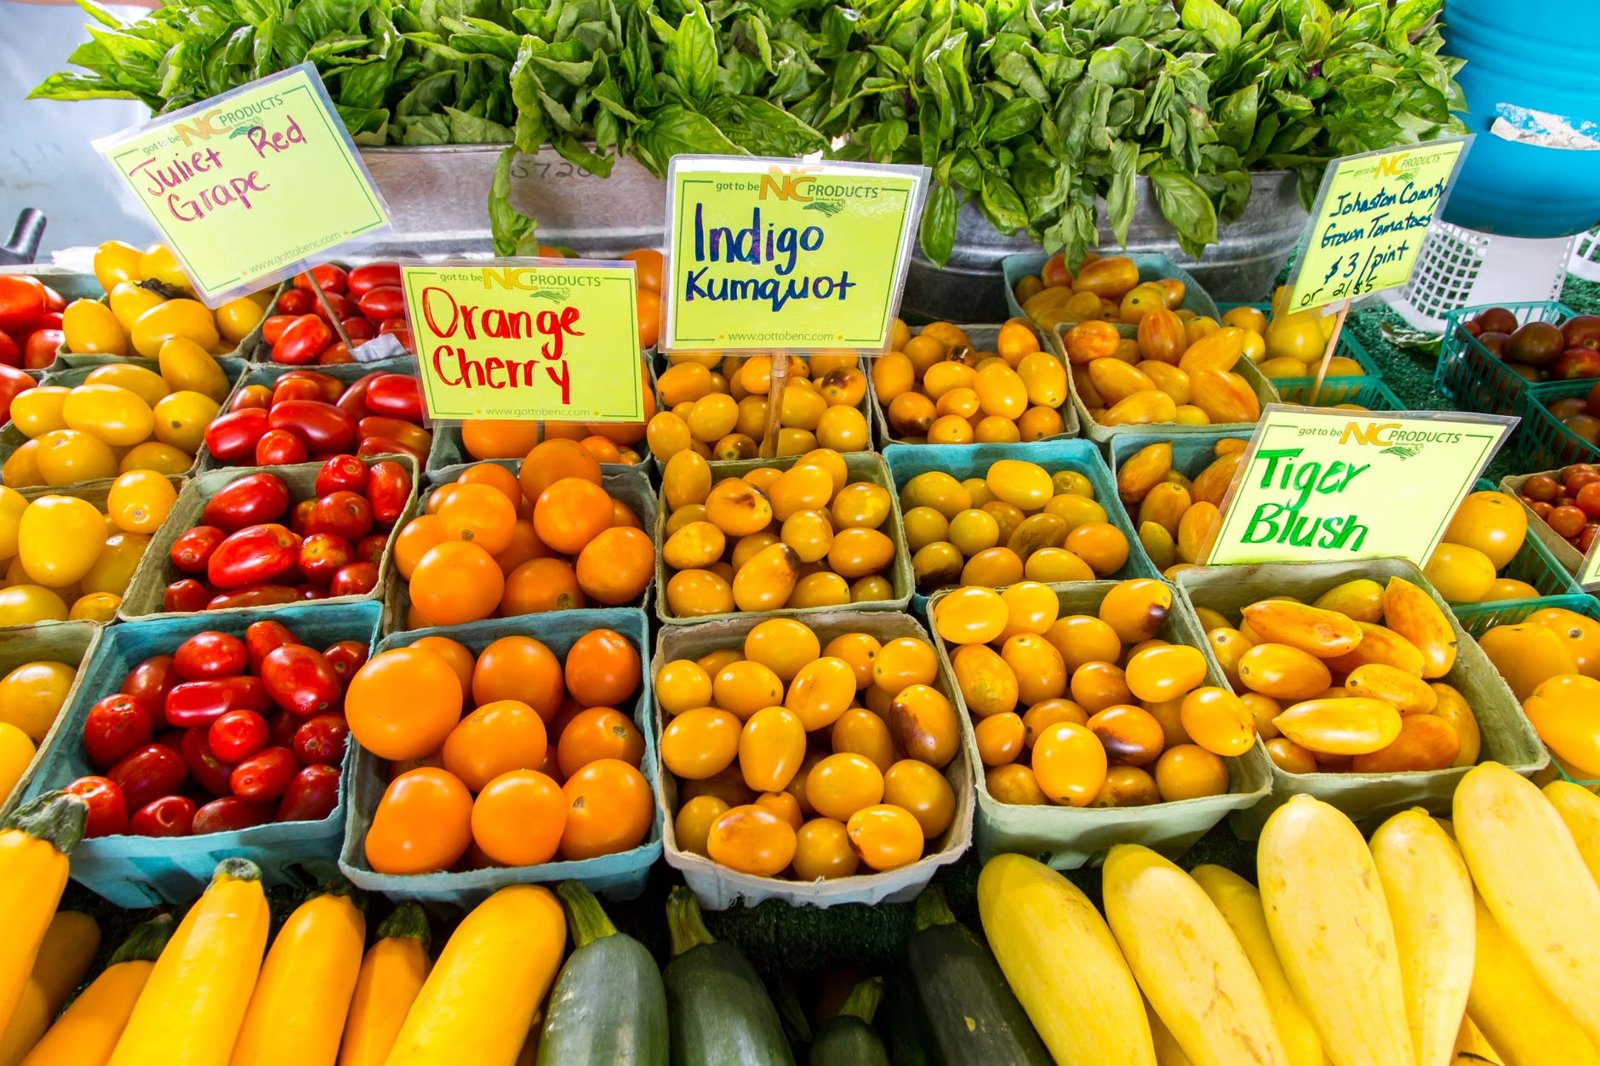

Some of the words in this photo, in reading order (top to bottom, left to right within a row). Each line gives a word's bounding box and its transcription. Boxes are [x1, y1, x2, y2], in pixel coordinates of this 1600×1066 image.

[143, 143, 159, 156] got
[167, 135, 181, 144] be
[174, 109, 232, 148] NC
[219, 94, 284, 127] PRODUCTS
[129, 147, 223, 197] Juliet
[247, 115, 308, 158] Red
[1374, 153, 1411, 180] NC
[1401, 154, 1441, 169] PRODUCTS
[167, 171, 270, 222] Grape
[716, 182, 733, 192] got
[735, 182, 745, 191] to
[747, 181, 760, 192] be
[759, 174, 817, 202] NC
[807, 184, 879, 199] PRODUCTS
[1329, 187, 1396, 218] Johnston
[1400, 177, 1448, 212] County
[695, 203, 824, 275] Indigo
[1321, 223, 1363, 248] Grown
[1367, 211, 1432, 239] Tomatoes
[249, 231, 341, 273] www.gottobenc.com
[440, 273, 457, 283] got
[459, 274, 468, 282] to
[470, 272, 483, 282] be
[482, 267, 539, 291] NC
[530, 274, 602, 287] PRODUCTS
[1300, 288, 1323, 306] or
[422, 287, 585, 360] Orange
[728, 331, 834, 343] www.gottobenc.com
[433, 345, 570, 404] Cherry
[485, 407, 590, 418] www.gottobenc.com
[1298, 427, 1316, 437] got
[1317, 427, 1328, 436] to
[1330, 427, 1343, 437] be
[1338, 421, 1403, 447] NC
[1388, 430, 1463, 444] PRODUCTS
[1255, 448, 1370, 510] Tiger
[1239, 503, 1369, 551] Blush
